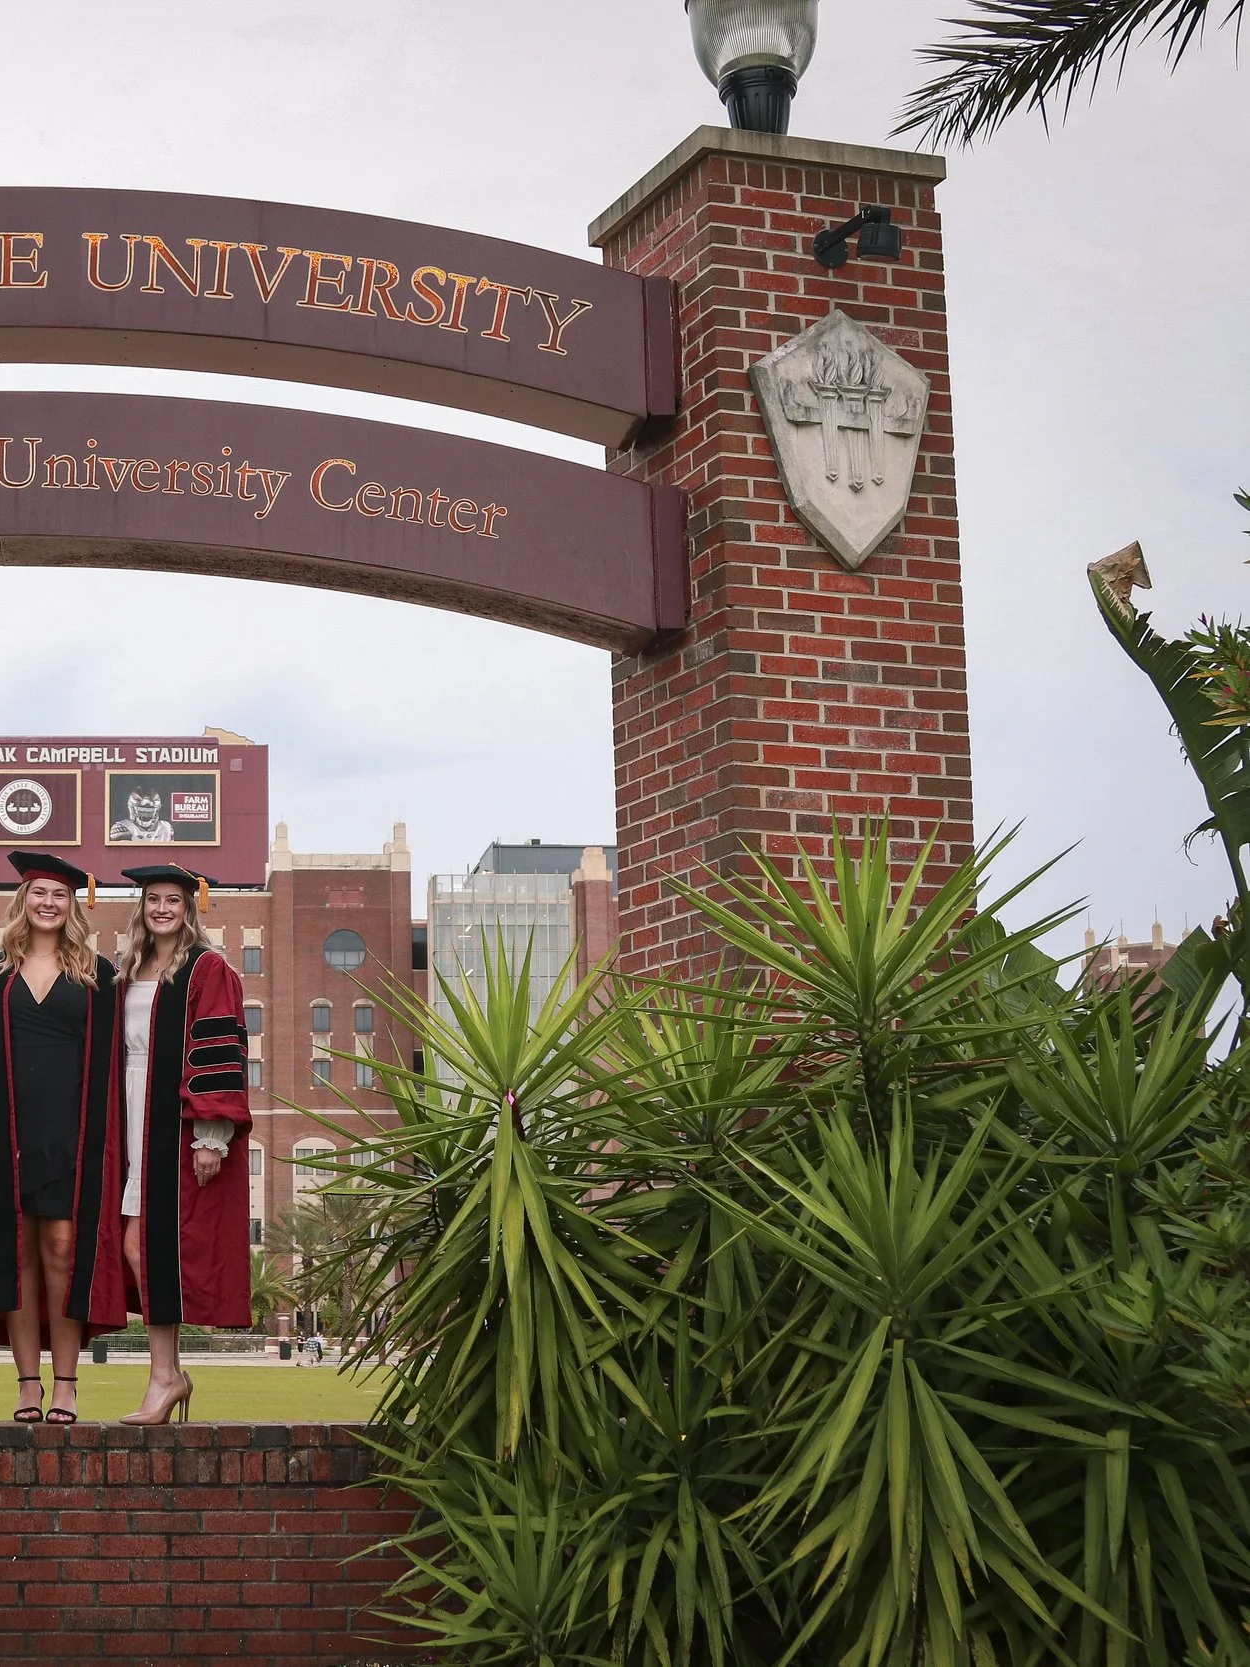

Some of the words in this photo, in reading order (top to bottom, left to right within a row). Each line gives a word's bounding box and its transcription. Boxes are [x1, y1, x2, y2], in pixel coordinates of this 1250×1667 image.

[82, 231, 593, 356] UNIVERSITY
[310, 458, 508, 539] Center
[26, 746, 127, 763] CAMPBELL
[135, 746, 219, 763] STADIUM
[174, 803, 209, 812] BUREAU
[184, 795, 209, 804] FARM
